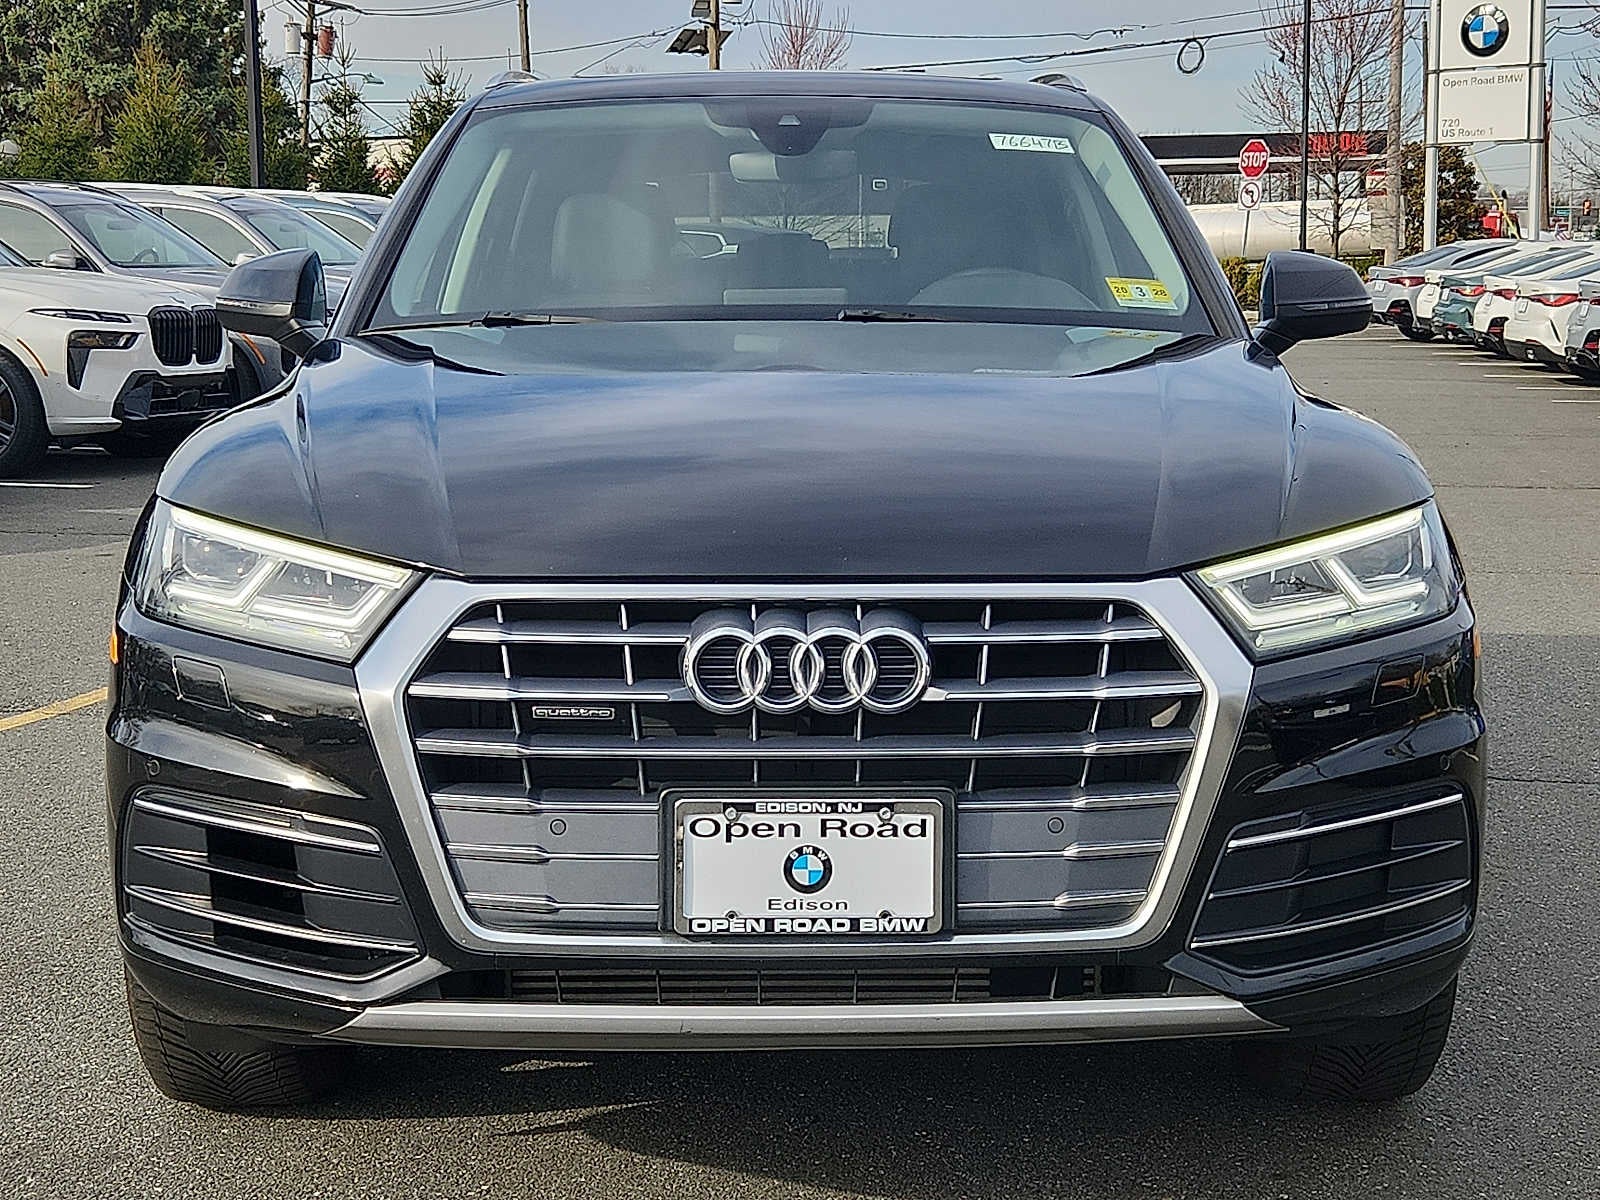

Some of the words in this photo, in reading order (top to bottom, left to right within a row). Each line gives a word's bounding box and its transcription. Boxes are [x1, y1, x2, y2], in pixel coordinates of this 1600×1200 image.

[1443, 78, 1468, 88] Open
[1471, 77, 1495, 86] Road
[1498, 74, 1523, 84] BMW
[1442, 119, 1460, 127] 720
[1441, 129, 1455, 138] US
[1458, 129, 1485, 137] Route
[994, 135, 1069, 150] 76647B
[1242, 152, 1267, 167] STOP
[1114, 286, 1128, 294] 20
[1135, 286, 1146, 297] 3
[535, 709, 611, 718] quattro
[755, 802, 832, 814] EDISON,
[837, 802, 863, 813] NJ
[689, 817, 801, 843] Open
[820, 818, 927, 838] Road
[790, 846, 828, 861] BMW
[767, 898, 848, 911] Edison
[691, 918, 770, 933] OPEN
[774, 918, 850, 933] ROAD
[859, 918, 925, 932] BMW
